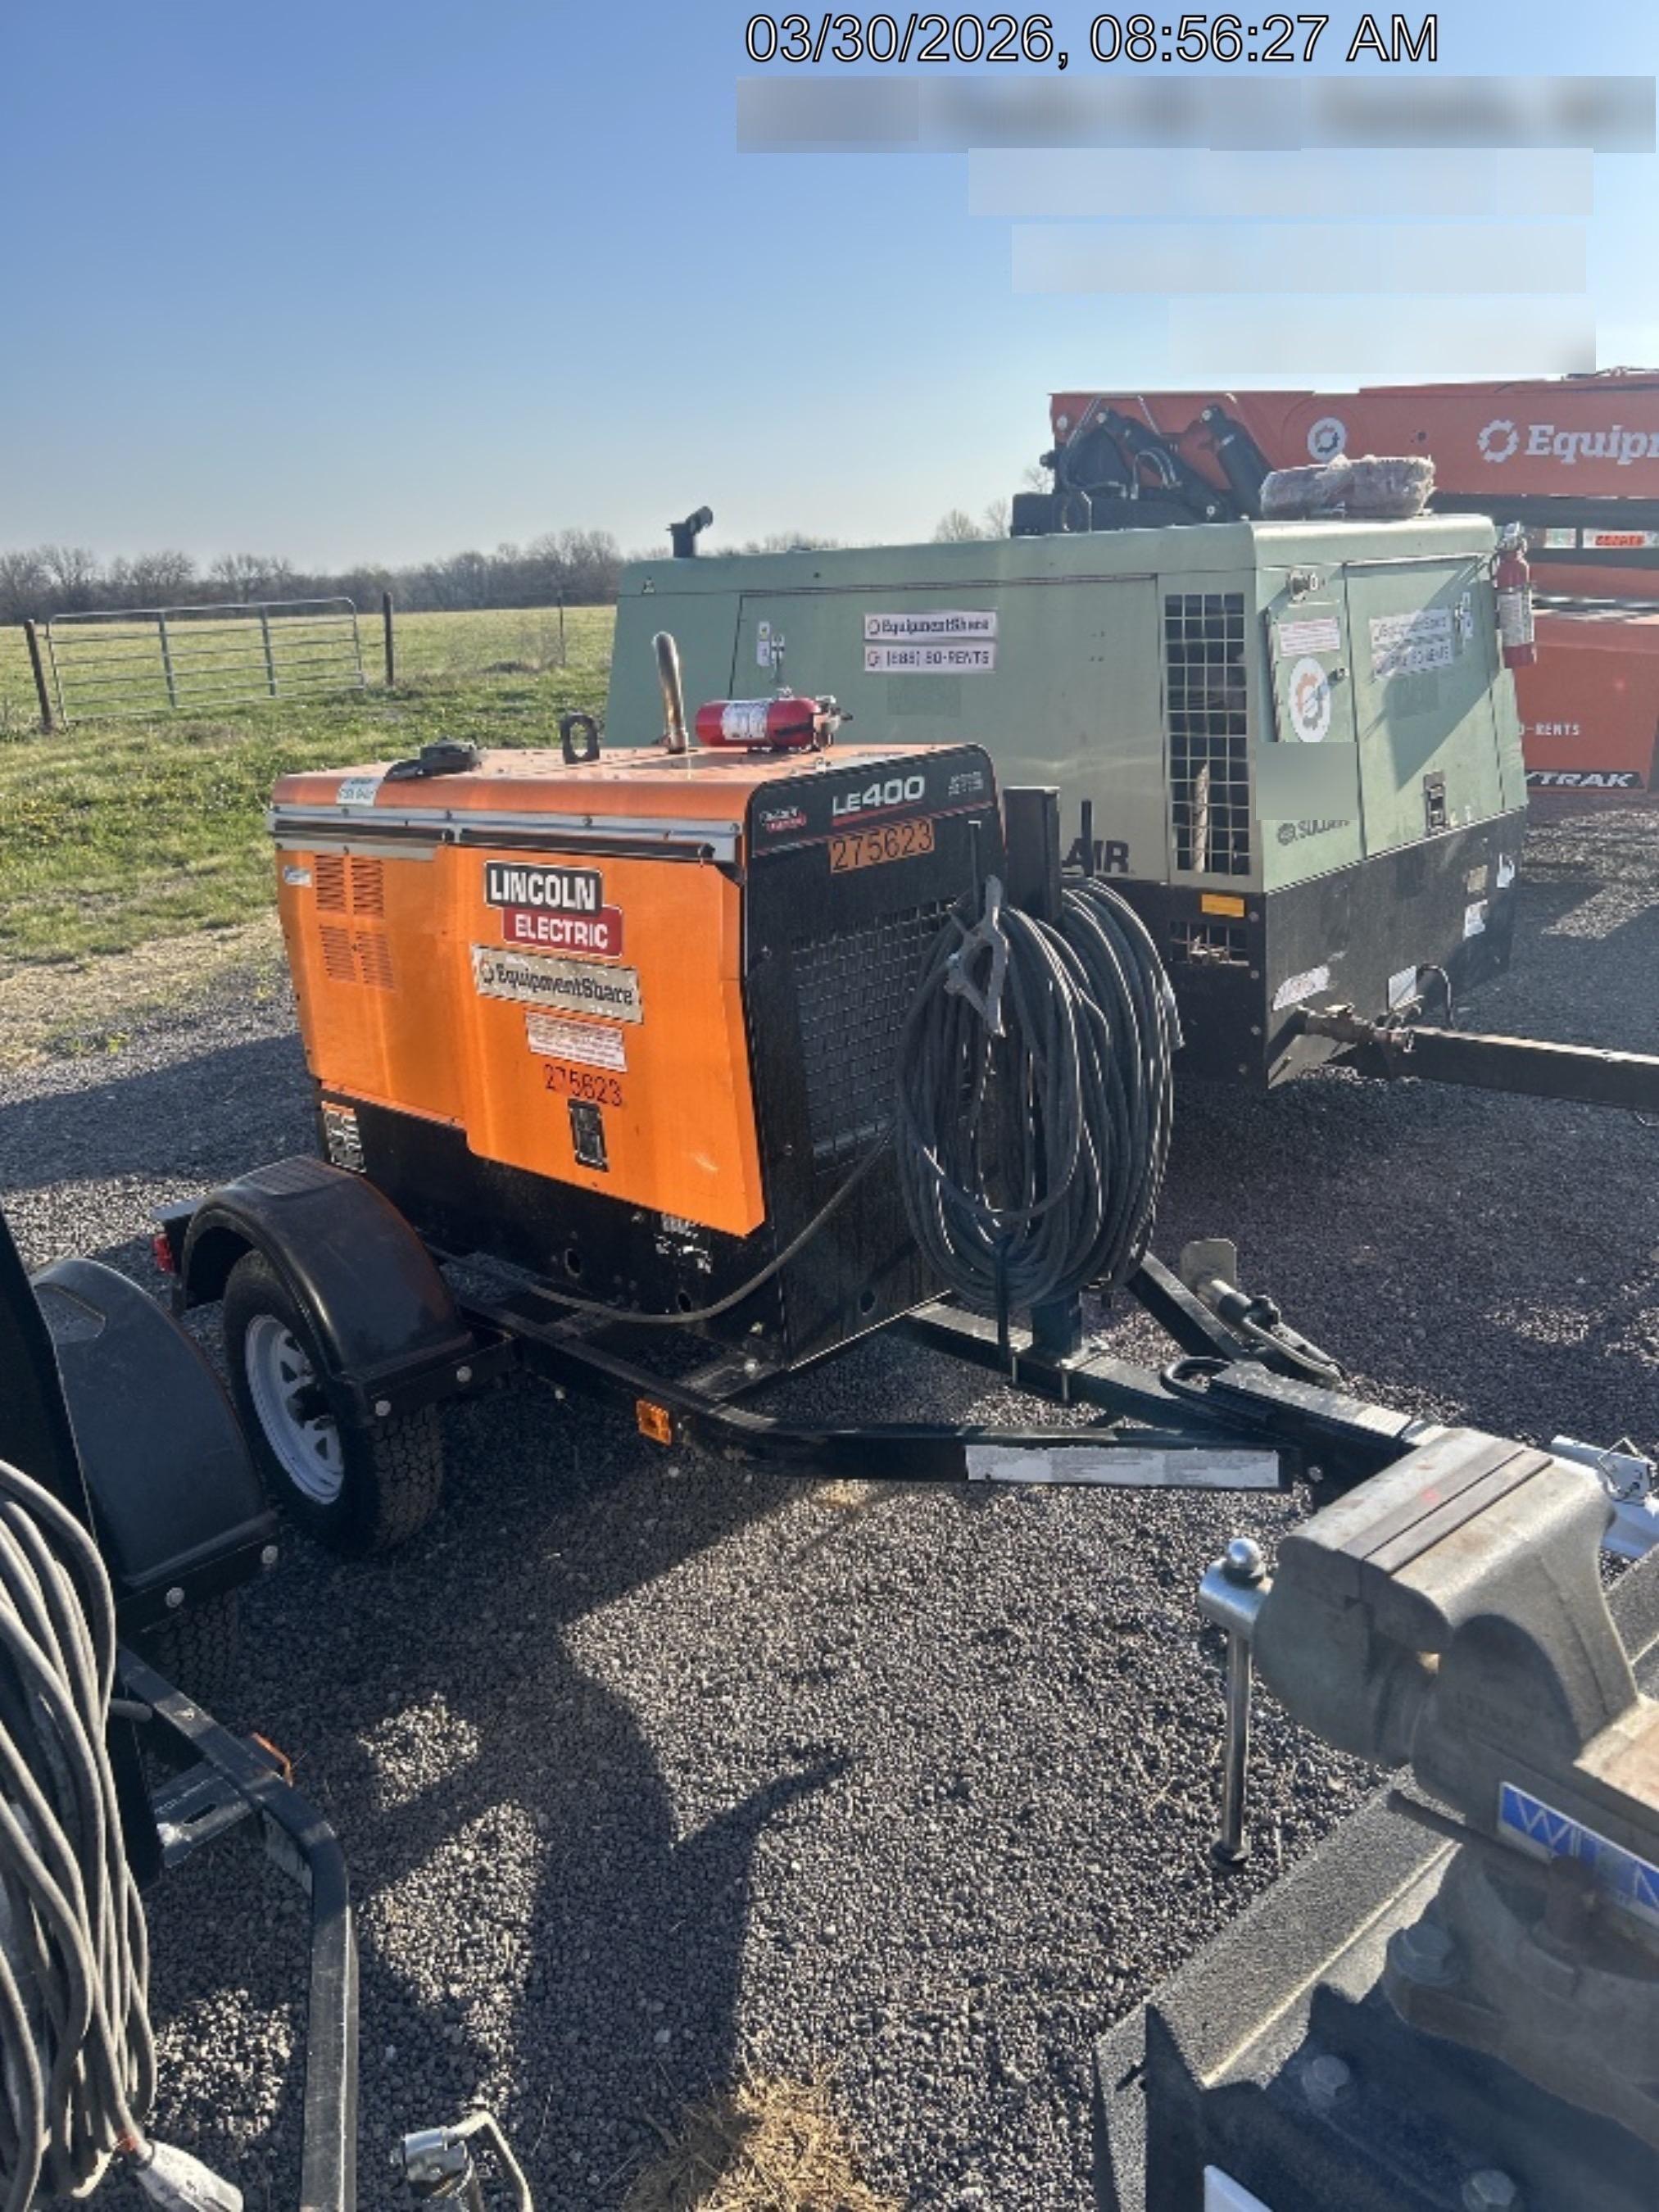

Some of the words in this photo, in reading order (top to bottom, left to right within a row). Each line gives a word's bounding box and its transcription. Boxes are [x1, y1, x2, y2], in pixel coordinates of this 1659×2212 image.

[1525, 424, 1659, 466] Equip
[832, 776, 925, 815] LE400
[832, 820, 932, 871] 275623
[491, 869, 596, 910] LINCOLN
[514, 913, 609, 950] ELECTRIC
[496, 963, 634, 1006] EquipmentShare
[545, 1063, 623, 1107] 275623
